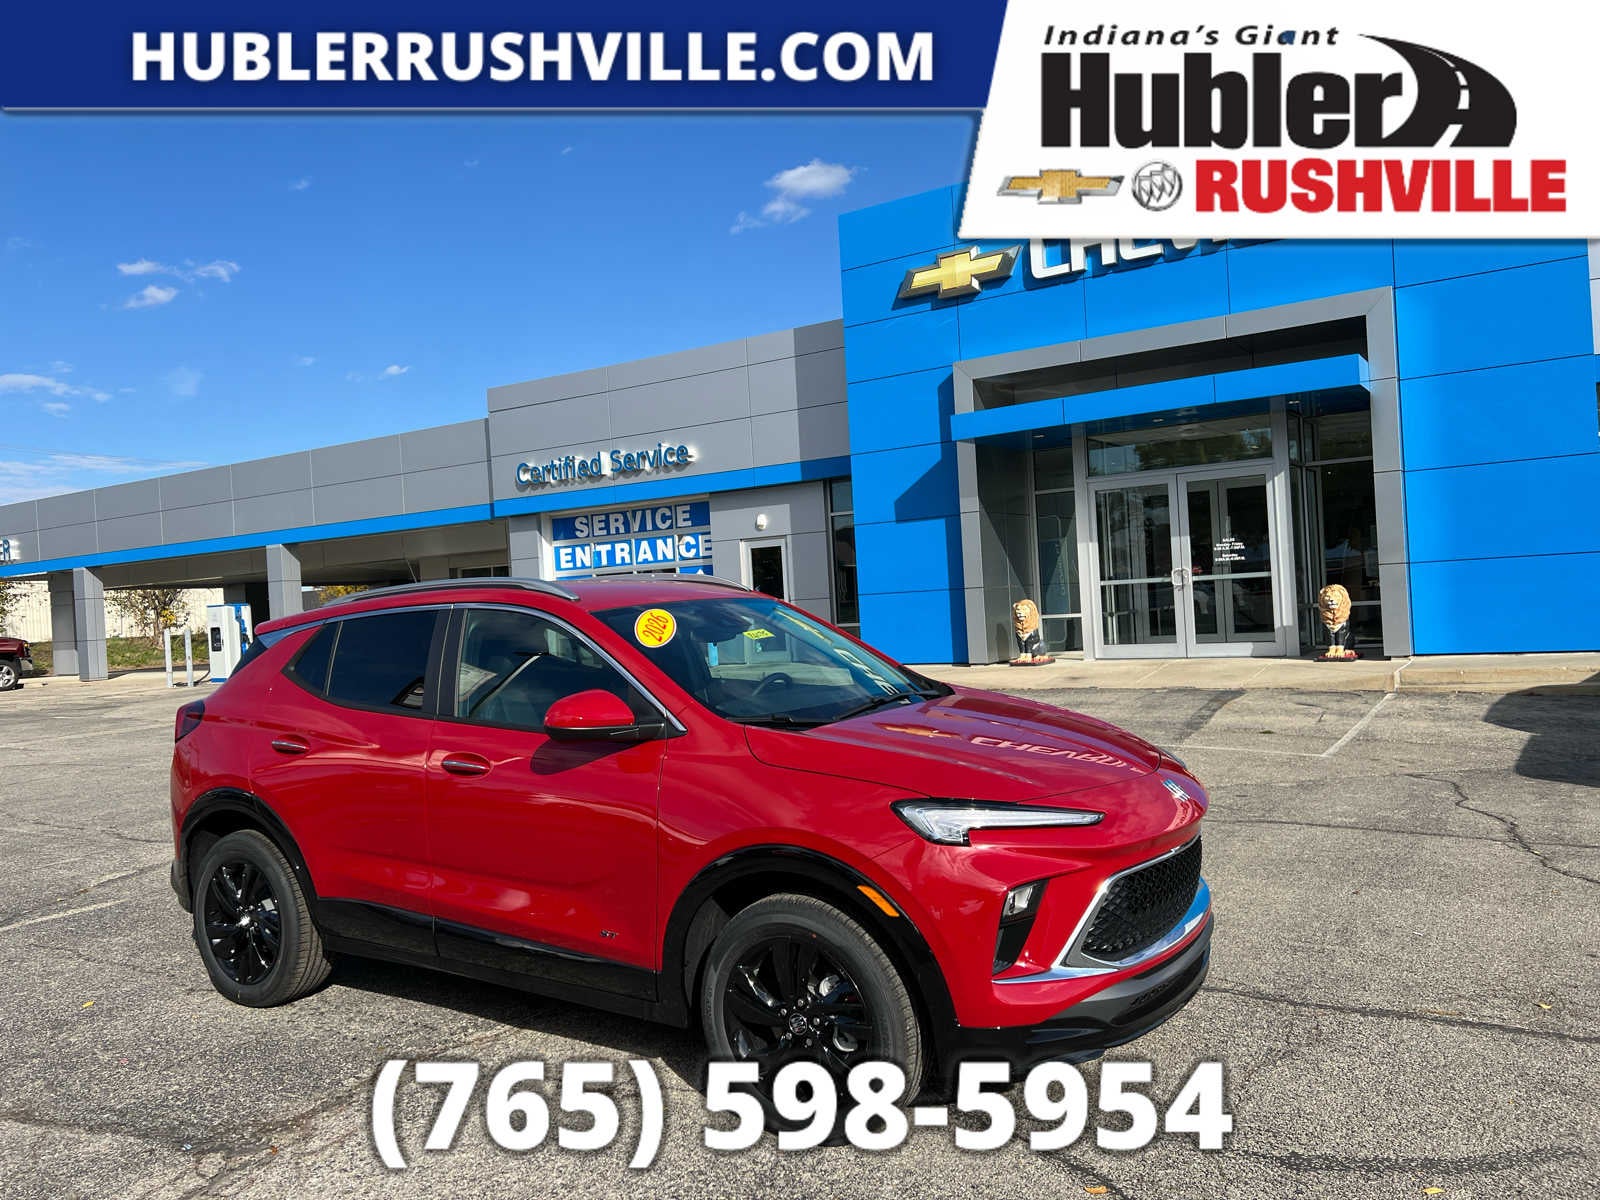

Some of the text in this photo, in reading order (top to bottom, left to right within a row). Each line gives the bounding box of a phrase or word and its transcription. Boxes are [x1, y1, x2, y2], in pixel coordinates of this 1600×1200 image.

[516, 442, 689, 485] Certified Service
[573, 503, 692, 538] SERVICE
[559, 533, 712, 569] ENTRANCE
[641, 612, 670, 643] 2026
